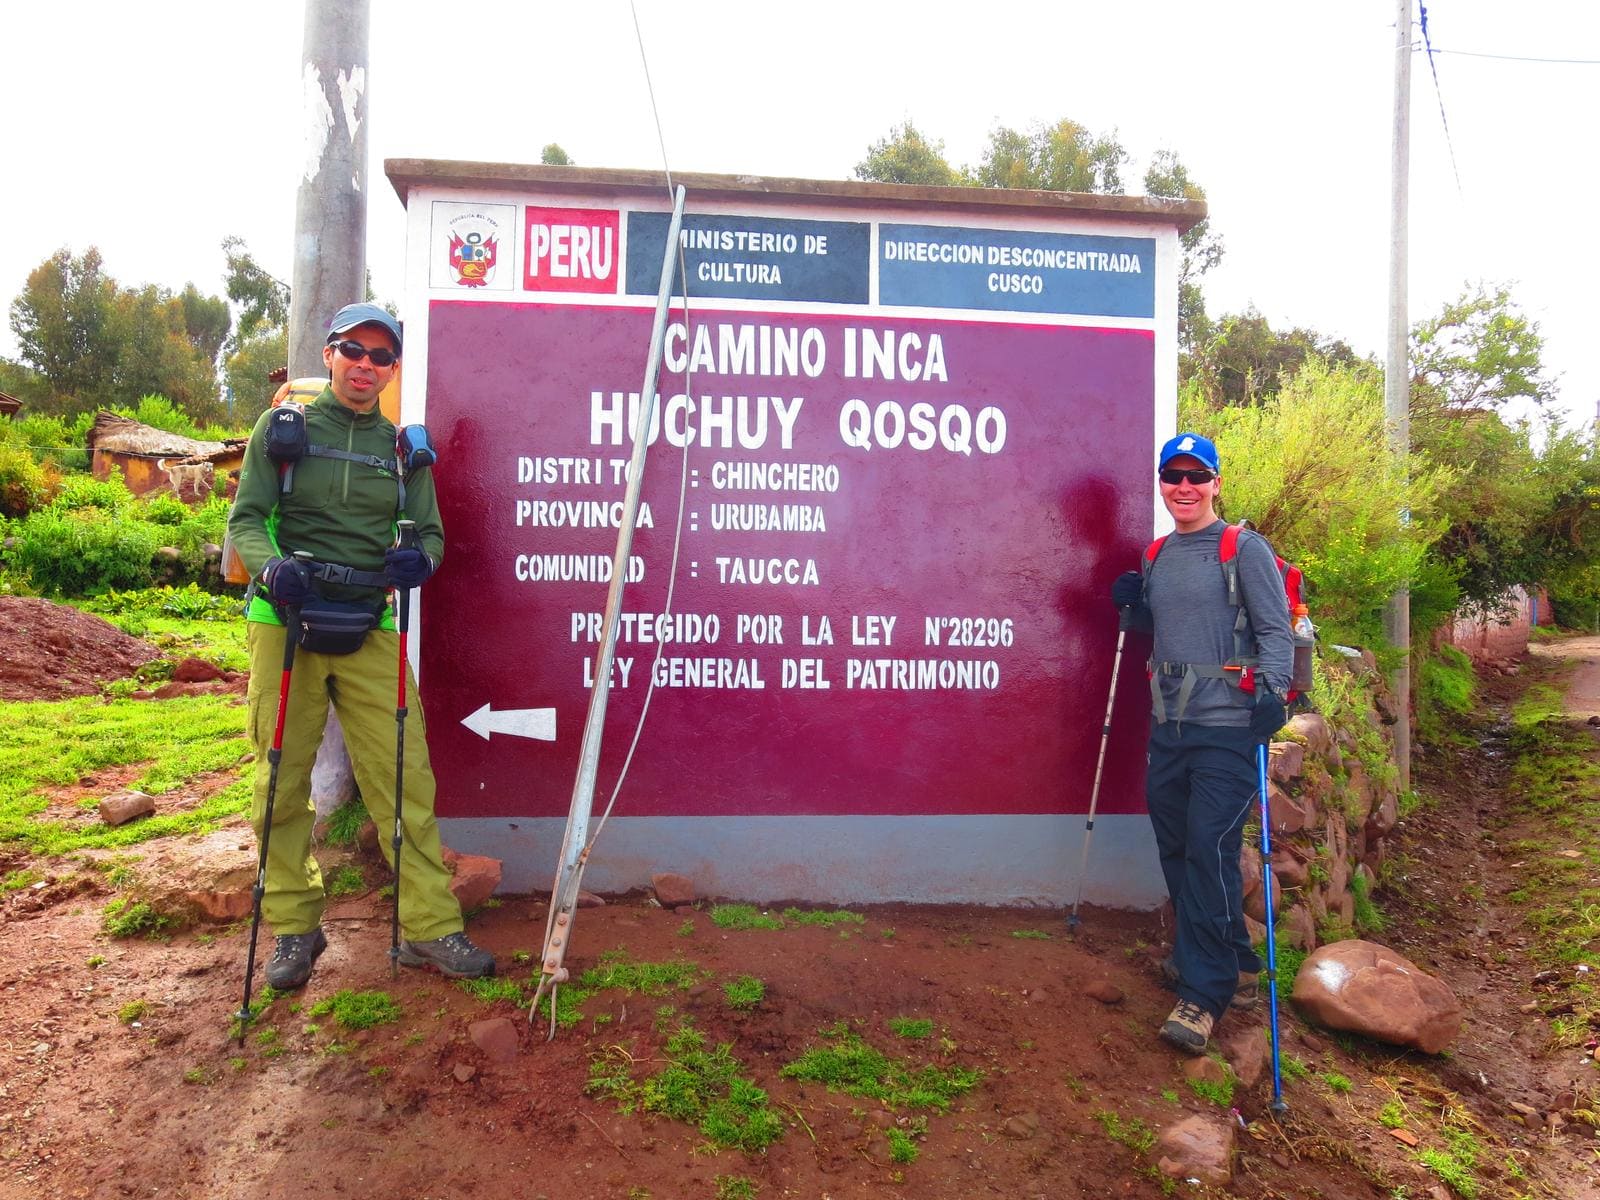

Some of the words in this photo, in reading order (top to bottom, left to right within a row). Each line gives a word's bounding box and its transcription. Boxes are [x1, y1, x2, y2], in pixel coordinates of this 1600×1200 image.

[529, 223, 613, 280] PERU
[804, 235, 828, 255] DE
[885, 241, 983, 264] DIRECCION
[987, 247, 1142, 274] DESCONCENTRADA
[698, 261, 782, 285] CULTURA
[988, 273, 1043, 294] CUSCO
[664, 322, 826, 378] CAMINO
[843, 328, 949, 383] INCA
[590, 391, 804, 450] HUCHUY
[839, 399, 1007, 457] QOSQO
[711, 461, 840, 492] CHINCHERO
[515, 500, 654, 529] PROVINCA
[710, 503, 826, 532] URUBAMBA
[515, 554, 645, 583] COMUNIDD
[716, 557, 820, 585] TAUCCA
[571, 612, 721, 644] PRTEGIDO
[736, 614, 783, 645] POR
[801, 615, 834, 646] LA
[852, 615, 897, 646] LEY
[653, 657, 766, 690] GENERAL
[781, 658, 831, 690] DEL
[846, 659, 1000, 690] PATRIMONIO
